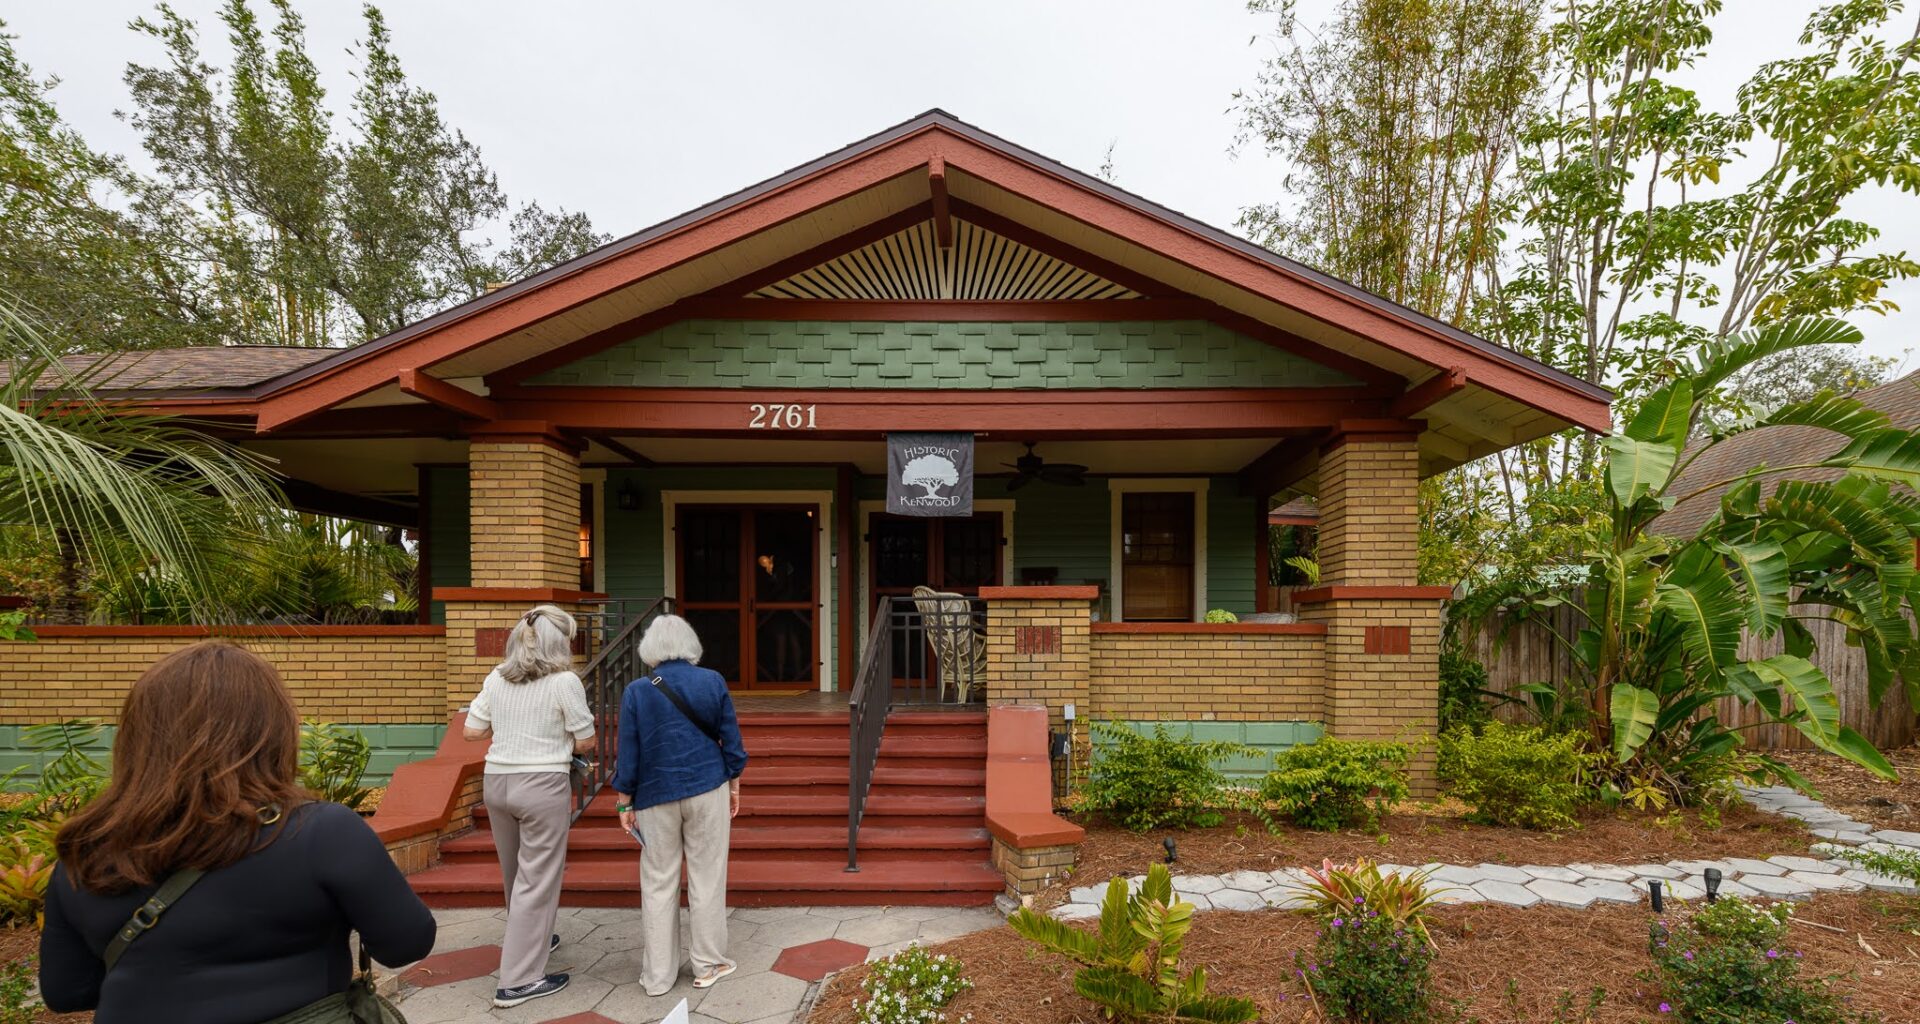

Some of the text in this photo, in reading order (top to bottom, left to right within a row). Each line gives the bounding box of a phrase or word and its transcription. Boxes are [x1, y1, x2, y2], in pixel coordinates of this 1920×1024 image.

[749, 404, 817, 429] 2761
[904, 446, 959, 462] HISTORIC
[900, 496, 960, 506] KENWOOD
